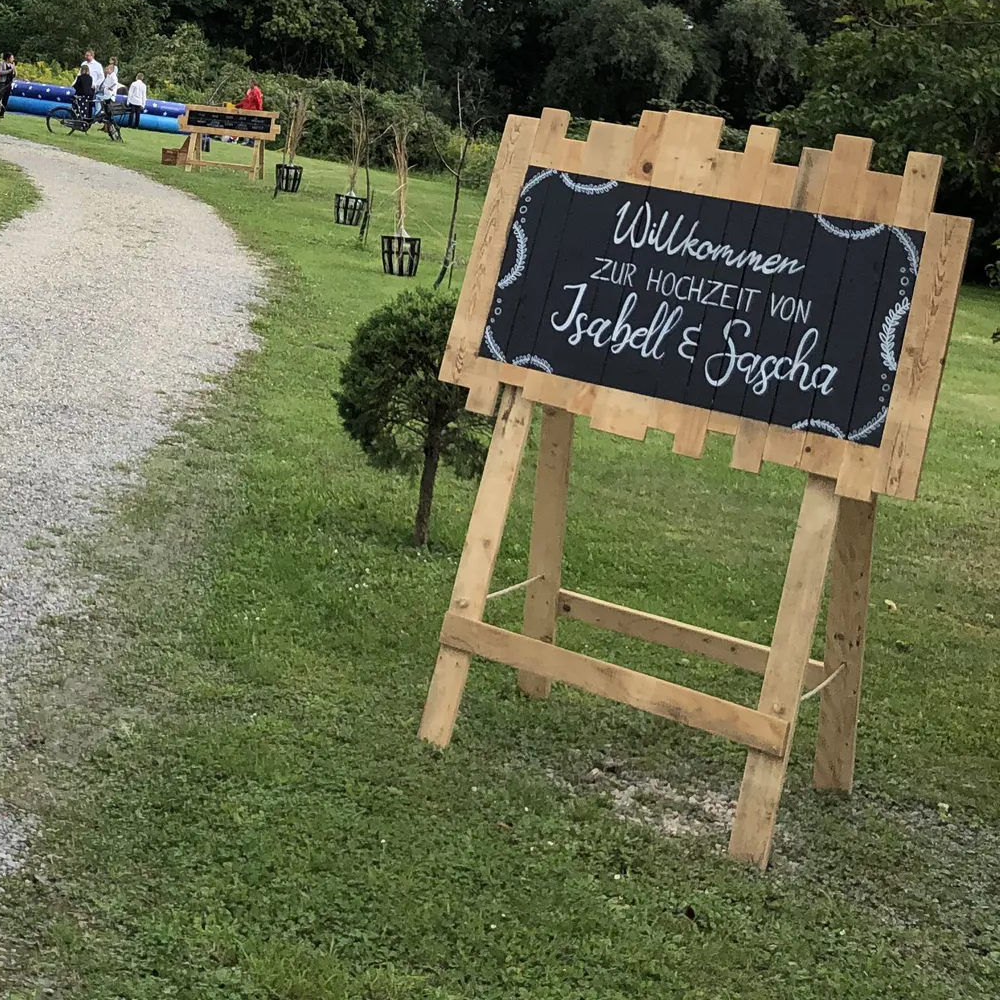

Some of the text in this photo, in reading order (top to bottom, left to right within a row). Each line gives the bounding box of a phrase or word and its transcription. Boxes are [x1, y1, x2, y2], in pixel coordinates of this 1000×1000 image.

[614, 201, 805, 276] Willkommen
[590, 257, 812, 324] ZUR HOCHZEIT VON
[551, 282, 839, 396] Isabell & Sascha
